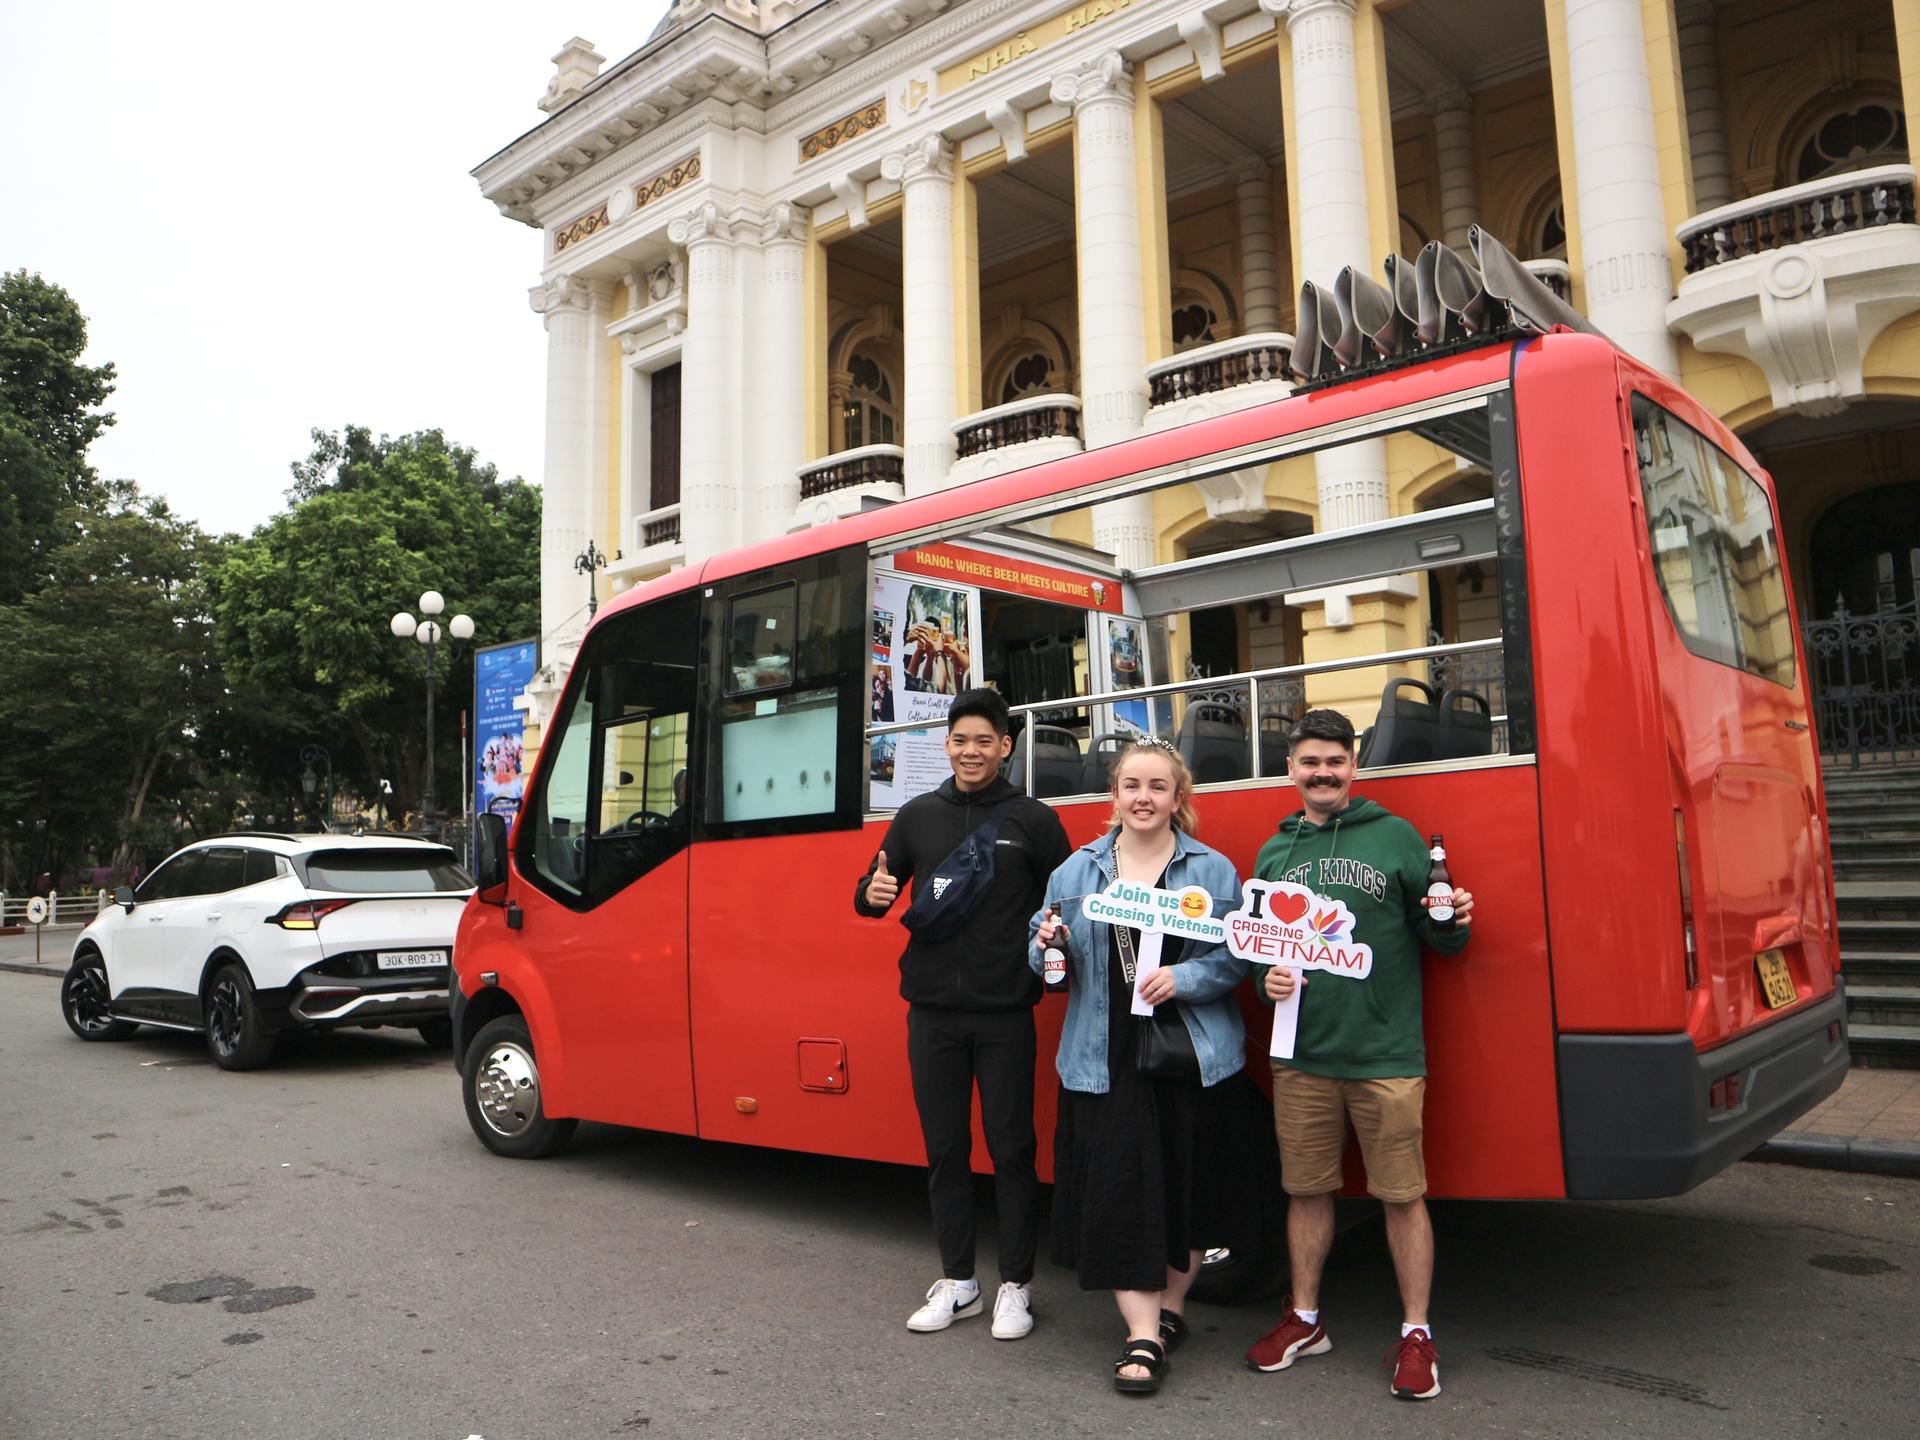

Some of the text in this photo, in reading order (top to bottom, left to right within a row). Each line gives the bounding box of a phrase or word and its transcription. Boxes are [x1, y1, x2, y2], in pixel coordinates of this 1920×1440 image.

[969, 32, 1039, 81] NHÀ
[916, 551, 1089, 598] HANOI: WHERE BEER MEETS CULTURE
[1110, 884, 1180, 909] Join us
[1281, 858, 1387, 902] ST KINGS
[1089, 900, 1224, 937] Crossing Vietnam
[1249, 888, 1266, 919] I
[1430, 896, 1453, 906] HANO
[1232, 919, 1304, 940] CROSSING
[1233, 932, 1364, 970] VIETNAM
